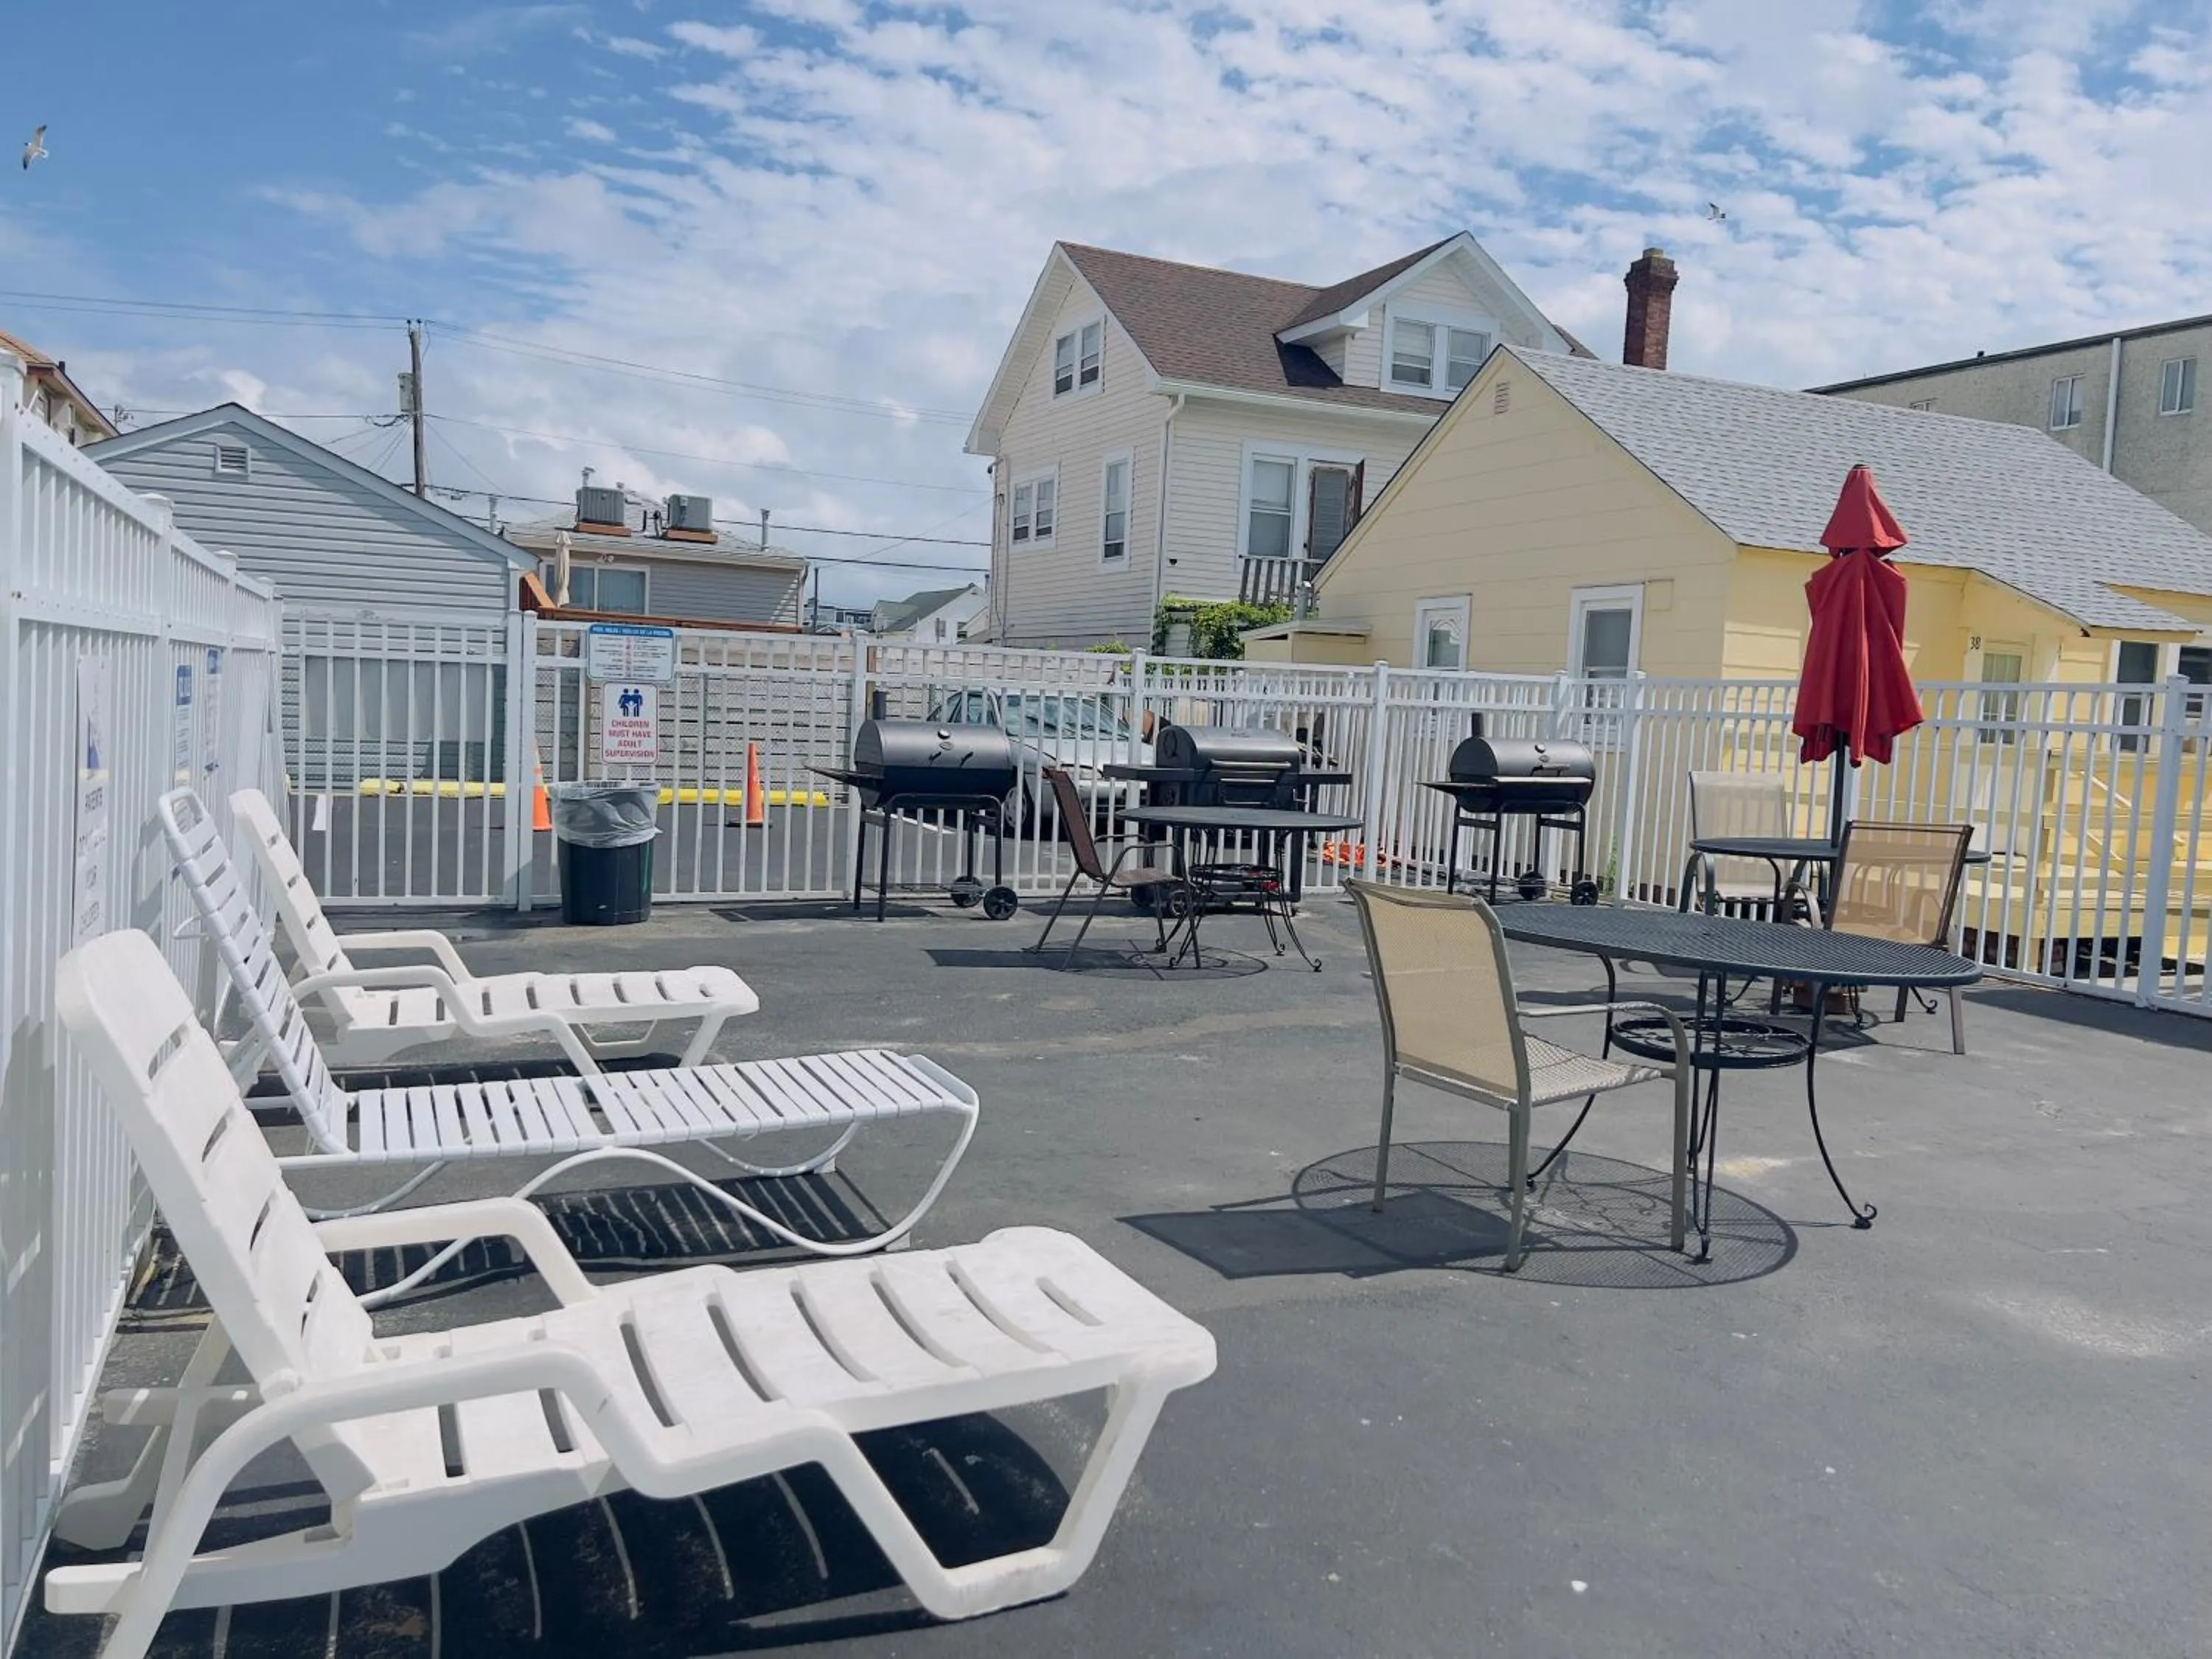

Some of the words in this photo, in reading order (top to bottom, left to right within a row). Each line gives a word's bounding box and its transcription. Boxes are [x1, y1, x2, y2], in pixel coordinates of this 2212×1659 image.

[1969, 636, 1981, 650] 38
[611, 719, 649, 728] CHILDREN
[605, 749, 654, 757] SUPERVISION
